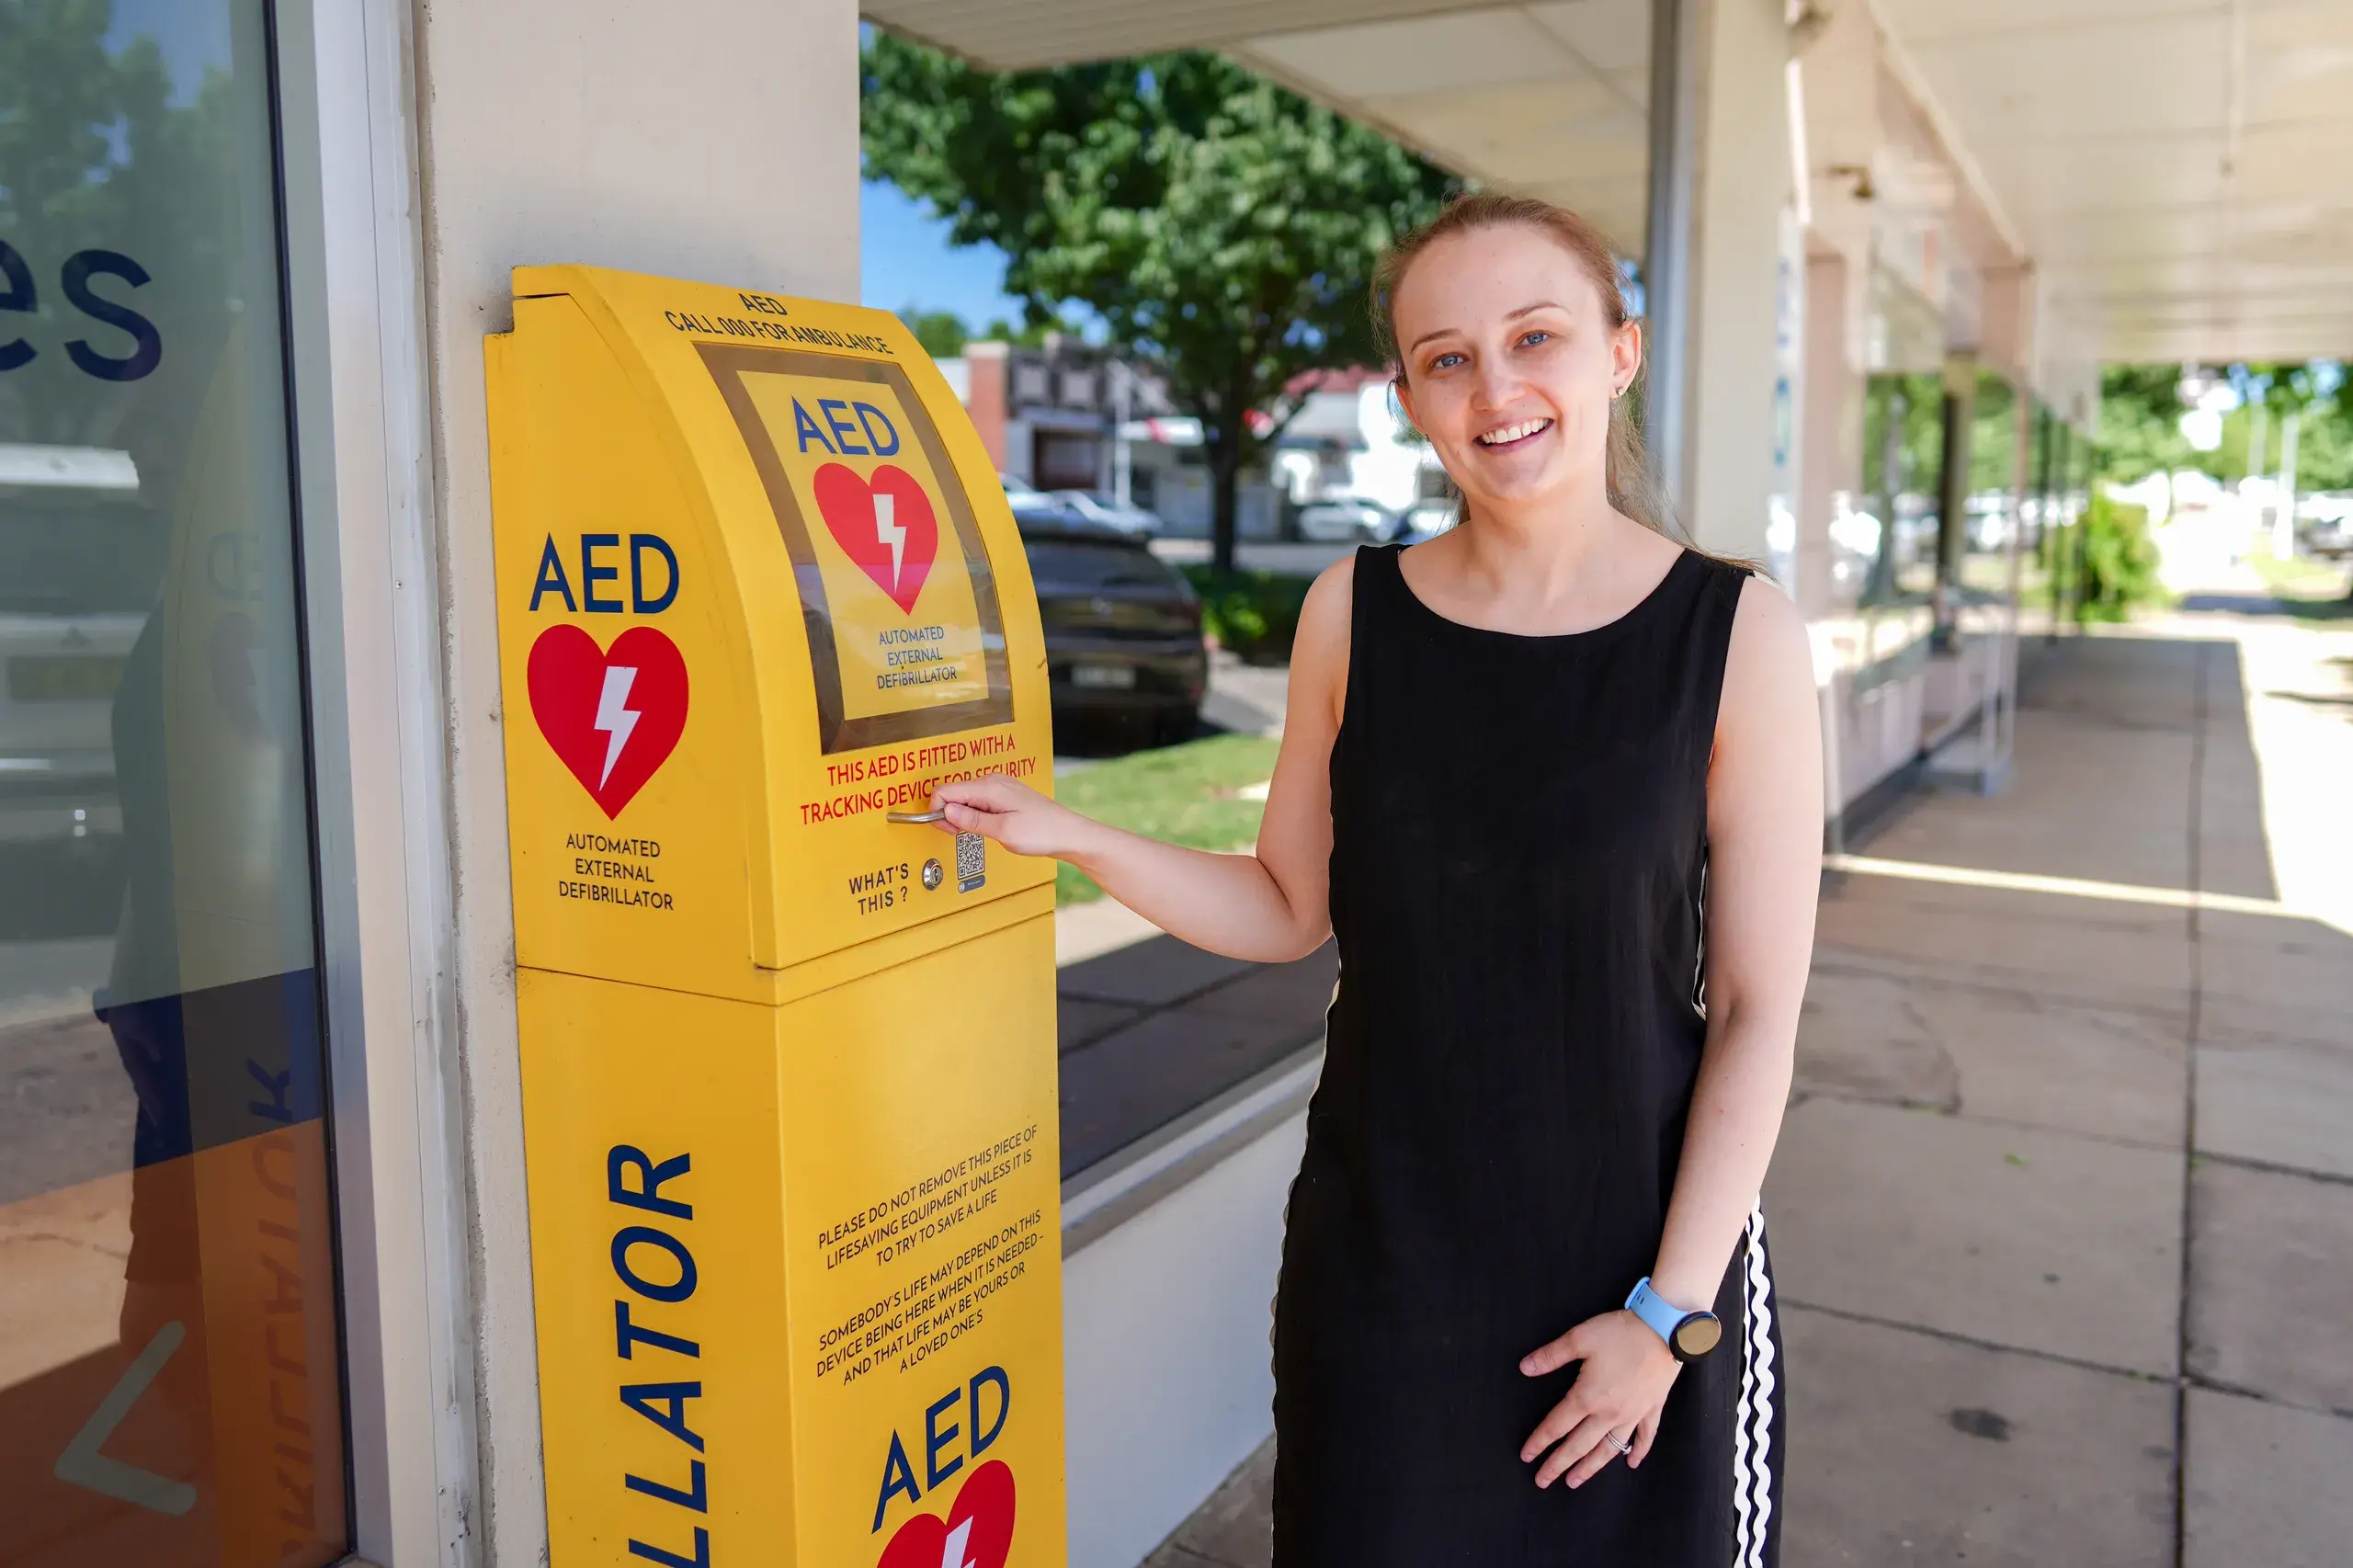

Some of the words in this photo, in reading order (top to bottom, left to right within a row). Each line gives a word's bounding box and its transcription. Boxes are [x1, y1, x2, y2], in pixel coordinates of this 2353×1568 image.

[738, 293, 788, 316] AED
[665, 311, 723, 335] CALL
[717, 317, 752, 337] 000
[749, 321, 796, 342] FOR
[790, 325, 894, 355] AMBULANCE
[791, 394, 900, 456] AED
[529, 531, 679, 614] AED
[879, 626, 944, 645] AUTOMATED
[887, 648, 943, 666] EXTERNAL
[877, 666, 957, 689] DEFIBRILLATOR
[827, 761, 864, 786] THIS
[868, 756, 898, 780] AED
[903, 751, 916, 770] IS
[919, 742, 967, 770] FITTED
[969, 735, 1006, 758] WITH
[1006, 733, 1016, 752] A
[801, 789, 883, 824] TRACKING
[566, 834, 661, 858] AUTOMATED
[575, 858, 654, 882] EXTERNAL
[559, 881, 674, 910] DEFIBRILLATOR
[849, 862, 909, 894] WHAT'S
[858, 890, 893, 915] THIS
[900, 886, 908, 902] ?
[819, 1212, 866, 1249] PLEASE
[869, 1202, 888, 1223] DO
[891, 1187, 917, 1212] NOT
[919, 1161, 966, 1198] REMOVE
[969, 1148, 992, 1172] THIS
[994, 1132, 1021, 1158] PIECE
[1024, 1124, 1038, 1142] OF
[827, 1220, 898, 1269] LIFESAVING
[901, 1182, 968, 1230] EQUIPMENT
[971, 1163, 1011, 1192] UNLESS
[1013, 1154, 1023, 1170] IT
[1024, 1148, 1032, 1165] IS
[876, 1247, 893, 1266] TO
[896, 1233, 917, 1256] TRY
[919, 1224, 935, 1244] TO
[938, 1207, 964, 1233] SAVE
[966, 1203, 974, 1218] A
[976, 1188, 997, 1213] LIFE
[819, 1292, 901, 1351] SOMEBODY'S
[904, 1276, 927, 1301] LIFE
[930, 1260, 955, 1286] MAY
[956, 1235, 999, 1270] DEPEND
[1001, 1226, 1017, 1244] ON
[1018, 1210, 1040, 1233] THIS
[816, 1337, 862, 1378] DEVICE
[866, 1314, 903, 1348] BEING
[905, 1294, 936, 1324] HERE
[938, 1272, 972, 1303] WHEN
[974, 1266, 983, 1281] IT
[985, 1258, 995, 1275] IS
[997, 1238, 1037, 1269] NEEDED
[843, 1358, 871, 1386] AND
[873, 1335, 904, 1365] THAT
[906, 1320, 930, 1346] LIFE
[932, 1303, 957, 1330] MAY
[959, 1294, 972, 1313] BE
[973, 1271, 1008, 1302] YOURS
[1010, 1261, 1025, 1279] OR
[608, 1144, 710, 1568] LLATOR
[900, 1359, 908, 1374] A
[910, 1333, 948, 1366] LOVED
[950, 1309, 983, 1340] ONE'S
[871, 1365, 1010, 1534] AED
